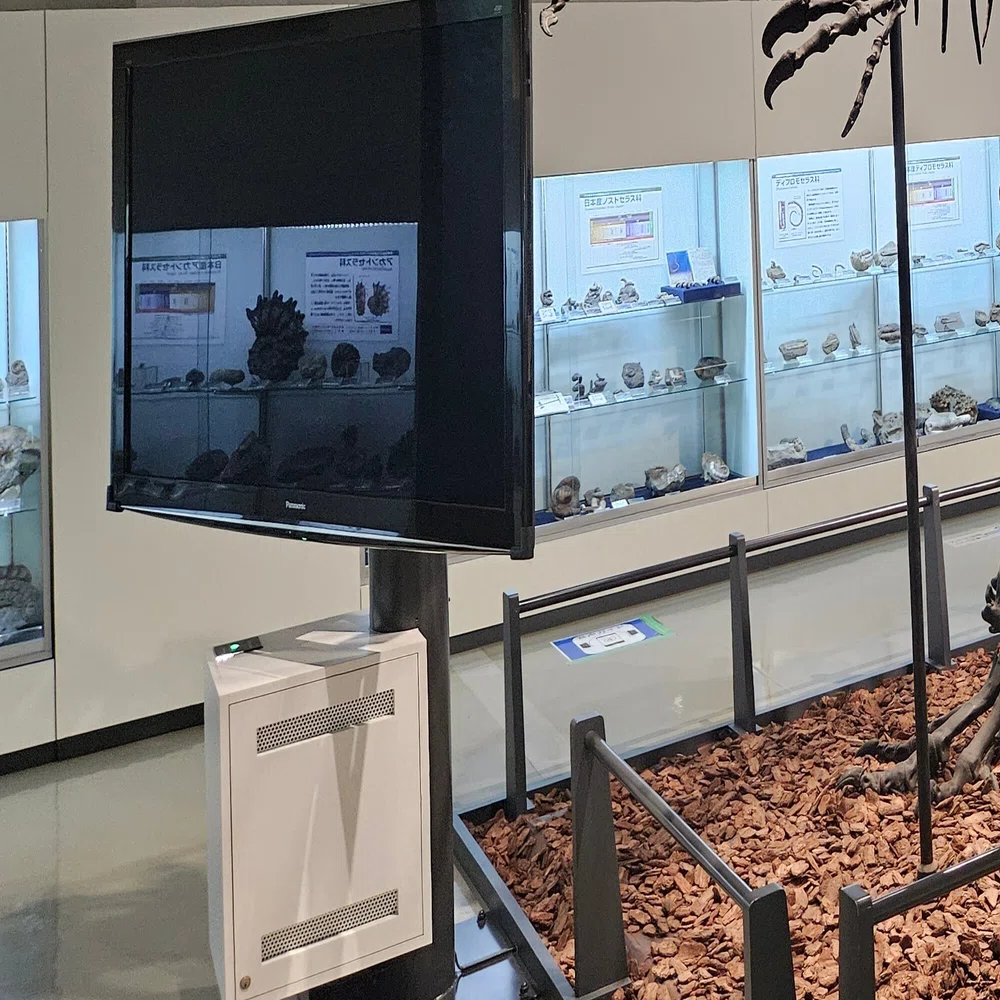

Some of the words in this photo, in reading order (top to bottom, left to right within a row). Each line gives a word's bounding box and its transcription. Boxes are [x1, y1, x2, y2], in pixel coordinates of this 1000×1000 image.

[584, 194, 642, 208] 日本産ノストセラス科
